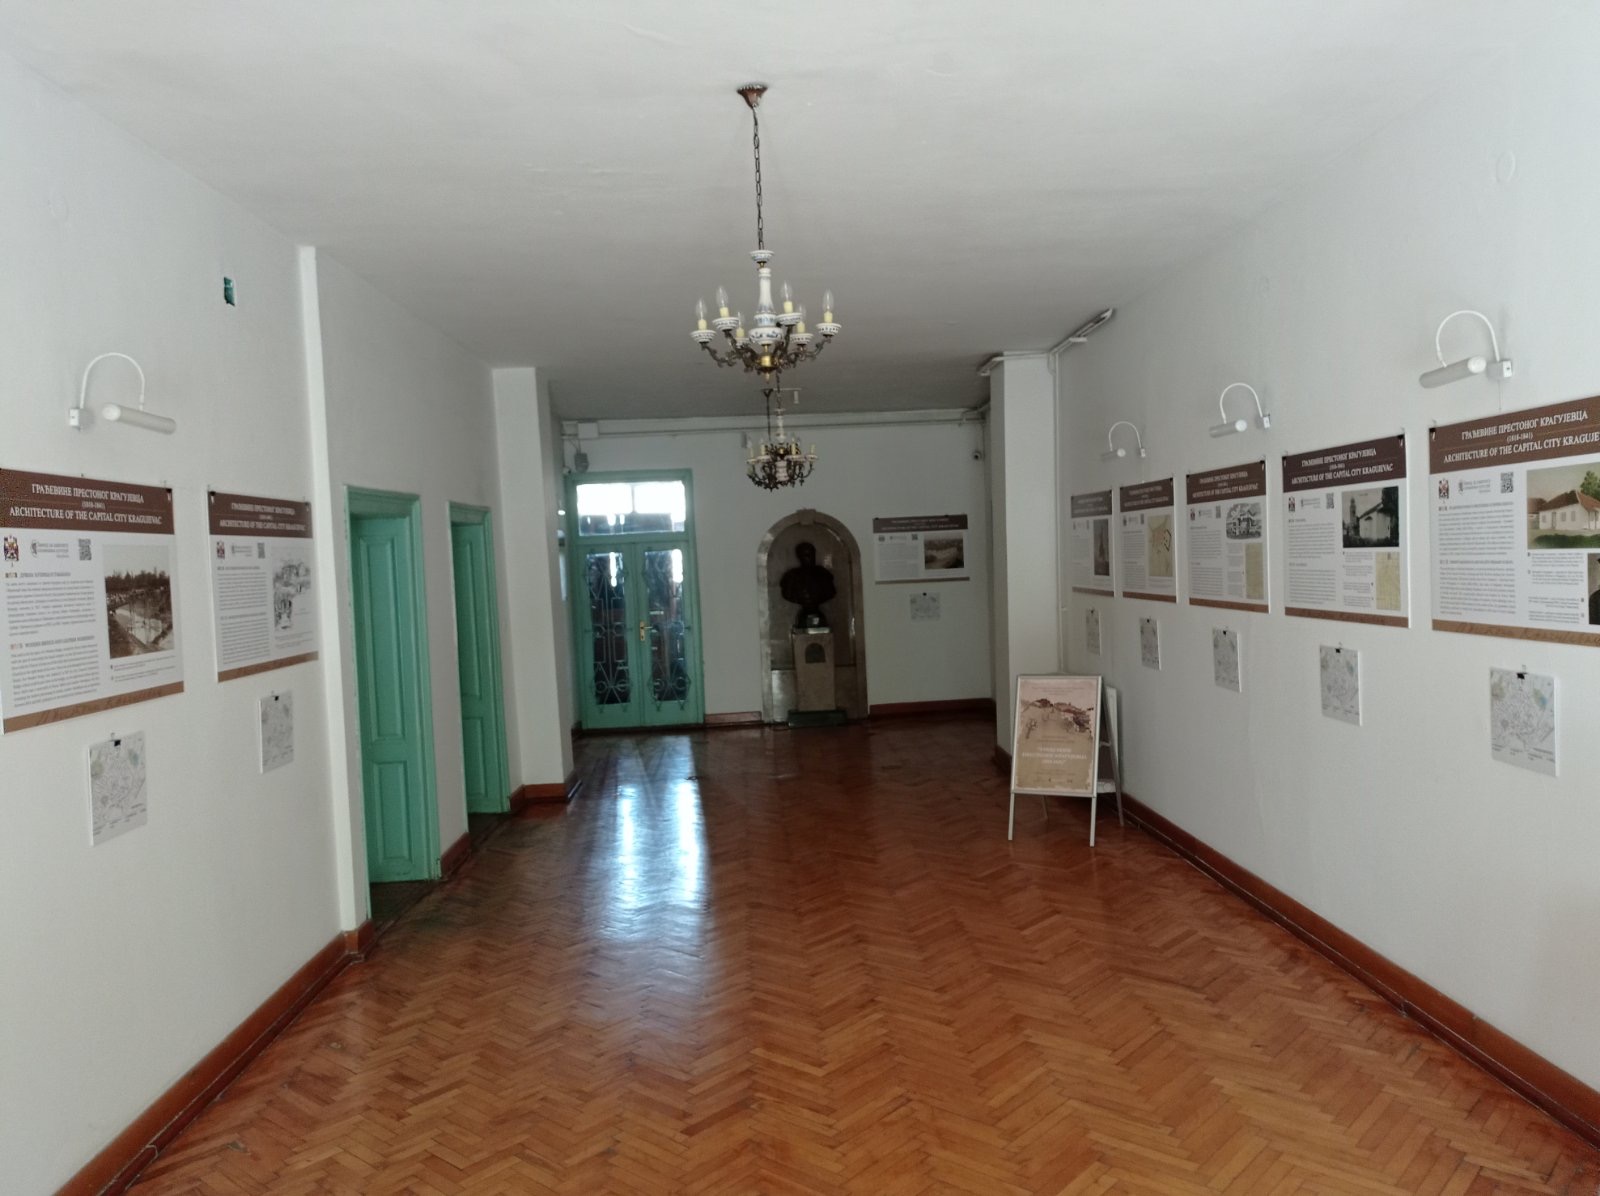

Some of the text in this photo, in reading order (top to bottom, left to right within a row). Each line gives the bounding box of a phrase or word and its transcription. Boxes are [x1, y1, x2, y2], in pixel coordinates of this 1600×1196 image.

[1461, 410, 1589, 441] ГРАЂЕВИНЕ ПРЕСТОНОГ КРАГУЈЕВЦА
[1443, 431, 1600, 464] ARCHITECTURE OF THE CAPITAL CITY KRAGUJE
[1351, 467, 1361, 476] CITY
[31, 483, 73, 497] ГРАЂЕВИНЕ
[73, 487, 109, 500] ПРЕСТОНОГ
[9, 506, 64, 519] ARCHITECTURE
[65, 509, 75, 519] OF
[75, 510, 88, 520] THE
[88, 511, 114, 523] CAPITAL
[114, 513, 128, 523] CITY
